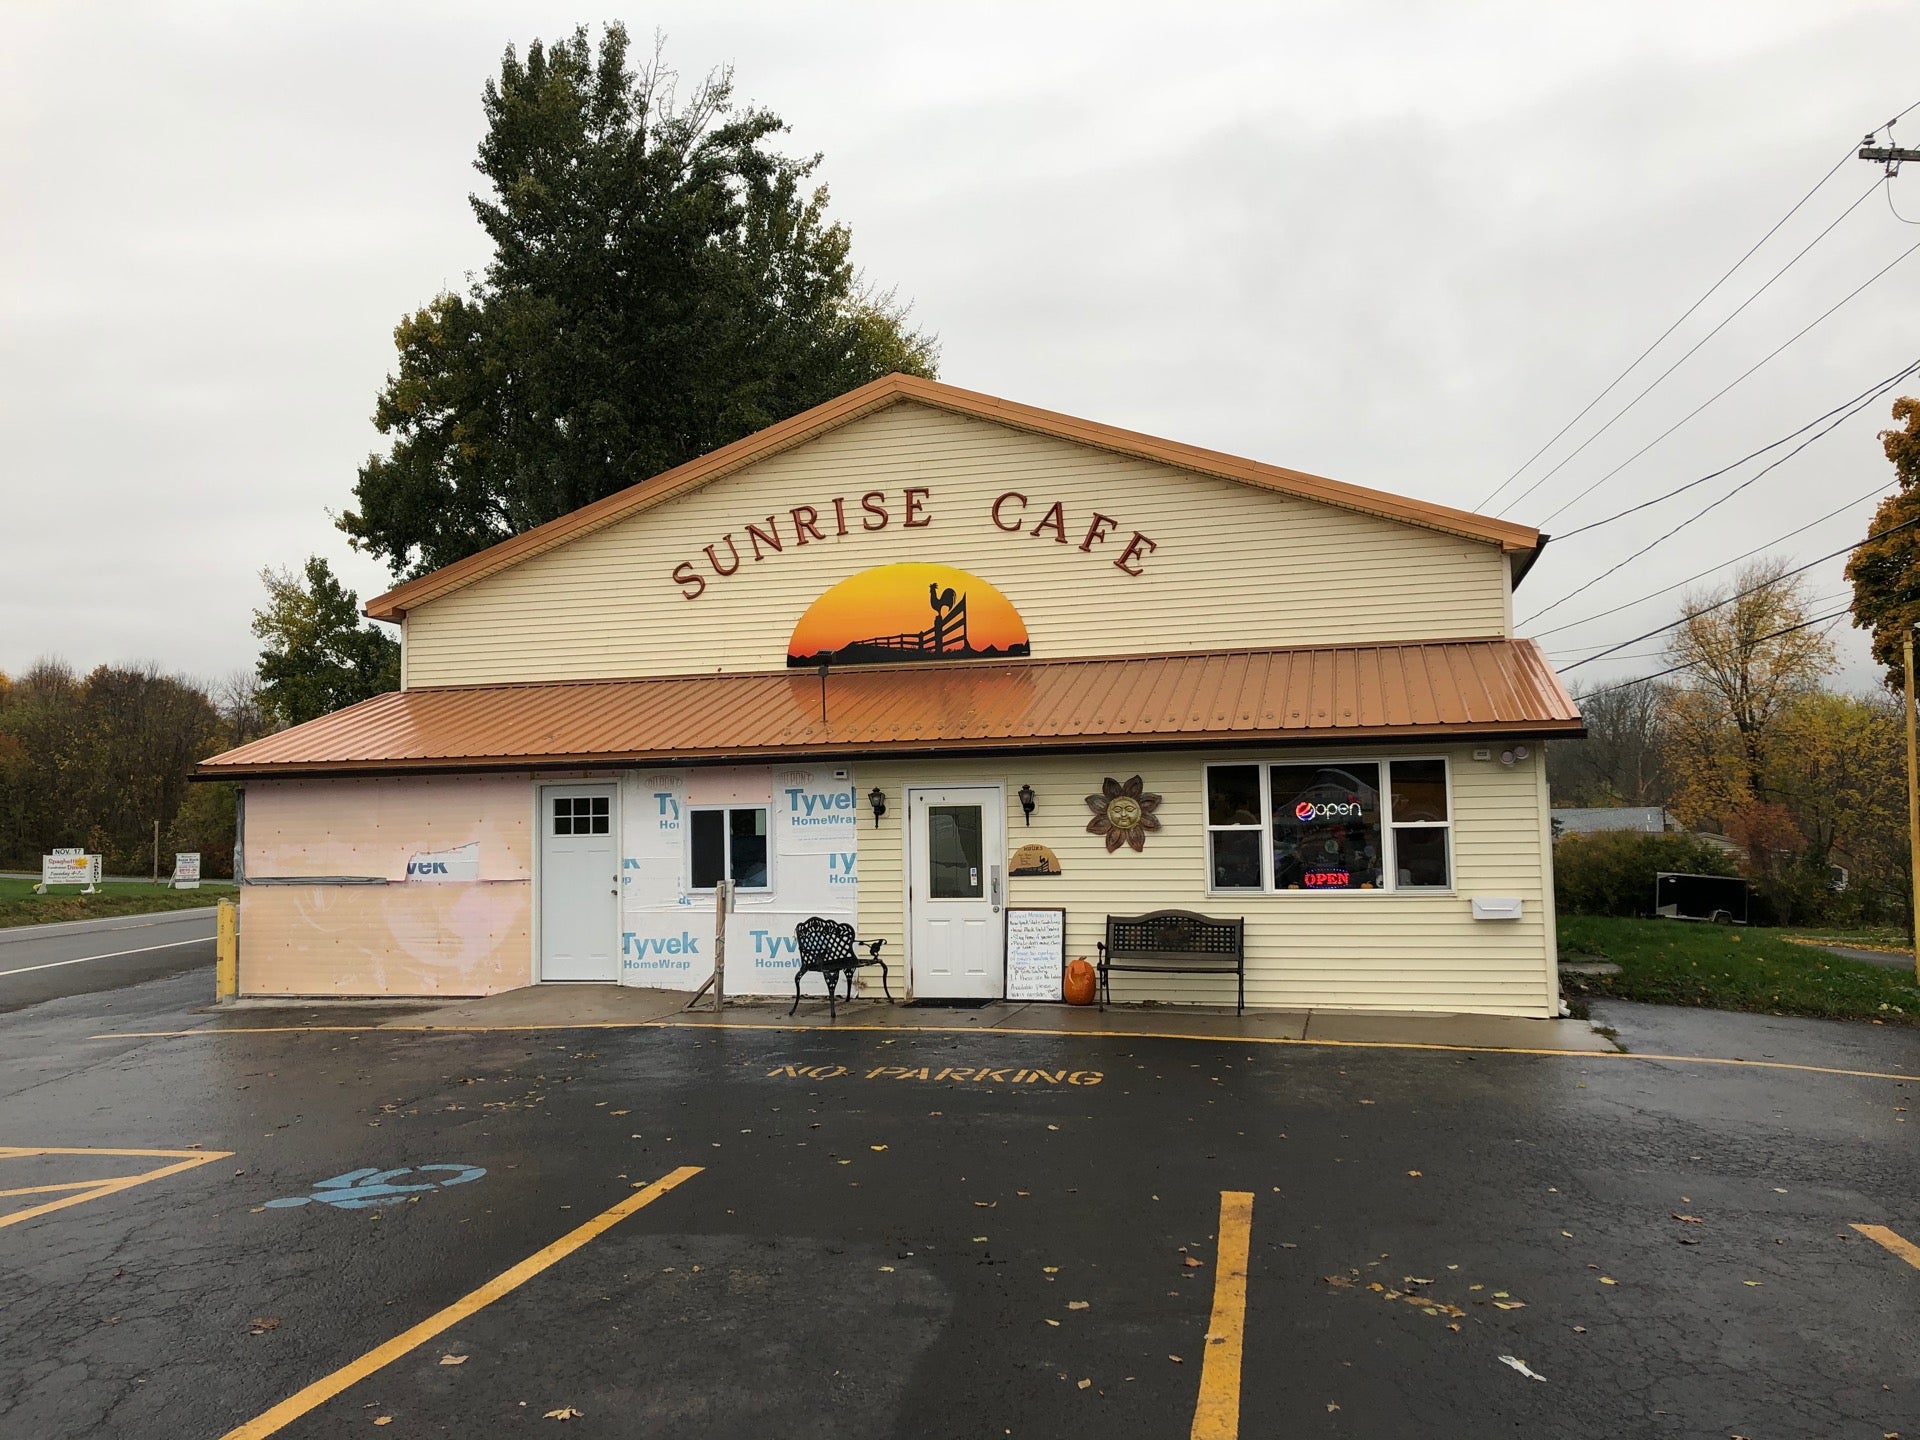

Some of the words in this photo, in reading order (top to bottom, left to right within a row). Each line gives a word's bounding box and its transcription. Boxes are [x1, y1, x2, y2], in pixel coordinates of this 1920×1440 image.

[673, 487, 932, 600] SUNRISE
[991, 491, 1157, 576] CAFE
[1315, 802, 1362, 820] open
[660, 820, 679, 829] Ho
[1304, 872, 1350, 886] OPEN
[622, 931, 700, 960] Tyvek
[749, 930, 800, 958] Tyv
[623, 959, 691, 970] HomeWrap
[766, 1065, 848, 1081] NO
[865, 1066, 1105, 1086] PARKING
